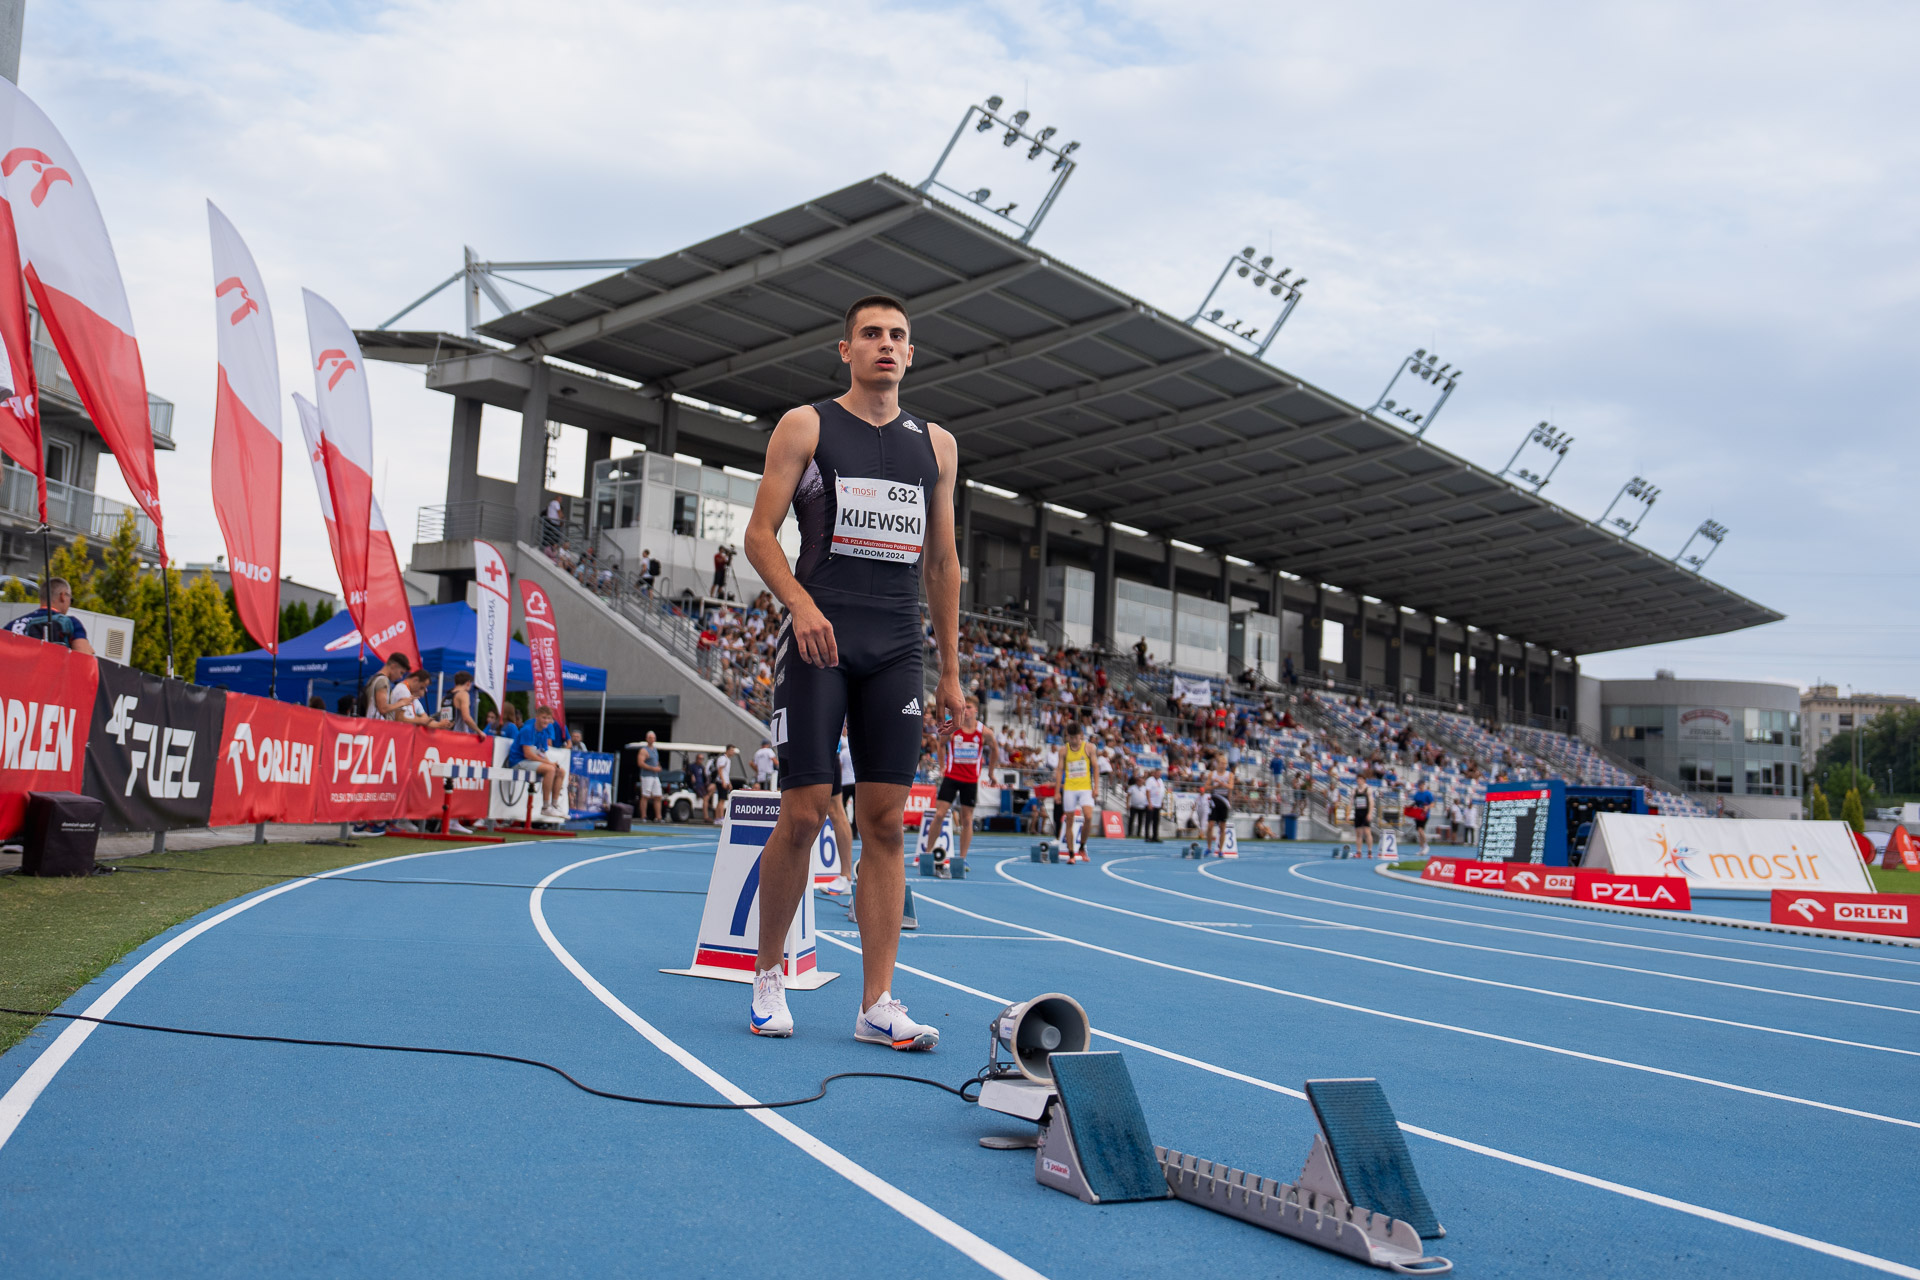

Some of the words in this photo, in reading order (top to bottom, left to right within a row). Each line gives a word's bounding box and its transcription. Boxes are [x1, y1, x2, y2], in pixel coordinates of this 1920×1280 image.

[852, 486, 877, 497] mosir
[887, 486, 918, 505] 632
[840, 507, 921, 535] KIJEWSKI
[853, 548, 884, 558] RADOM
[885, 551, 905, 560] 2024
[562, 671, 588, 682] adom.pl
[773, 712, 783, 742] 7
[124, 721, 201, 799] FUEL
[257, 736, 314, 785] ORLEN
[332, 732, 398, 785] PZLA
[735, 804, 763, 815] RADOM
[765, 805, 781, 815] 202
[904, 795, 932, 812] LEN
[819, 817, 836, 868] 6
[1226, 828, 1234, 849] 3
[1386, 834, 1394, 852] 2
[1708, 845, 1820, 881] mosir
[1465, 868, 1506, 885] PZL
[1548, 877, 1575, 888] ORL
[1590, 882, 1676, 903] PZLA
[1839, 906, 1903, 921] ORLEN
